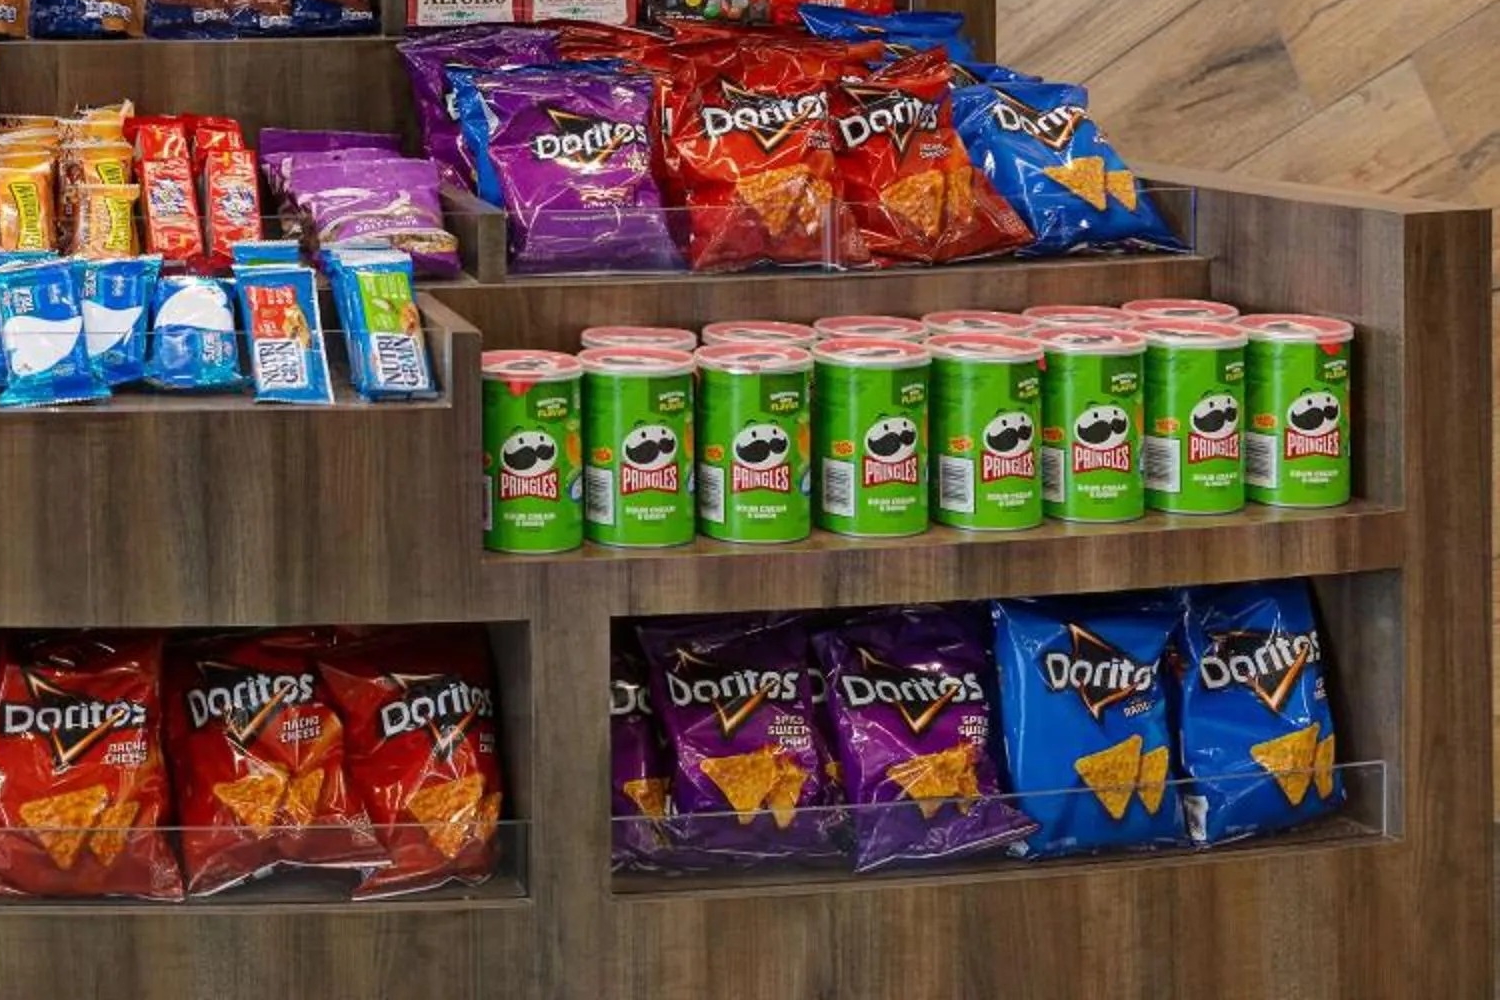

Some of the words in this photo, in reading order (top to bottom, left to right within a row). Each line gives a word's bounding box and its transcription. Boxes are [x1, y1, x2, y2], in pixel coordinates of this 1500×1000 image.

[536, 121, 647, 159] Doritos
[376, 335, 405, 387] NUTRI
[1075, 445, 1130, 472] PRINGLES
[1287, 431, 1339, 458] PRINGLES
[622, 465, 677, 493] PRINGLES
[733, 464, 789, 492] PRINGLES
[865, 456, 917, 485] PRINGLES
[983, 452, 1034, 483] PRINGLES
[500, 471, 557, 499] PRINGLES
[188, 672, 316, 728] Doritos
[667, 667, 799, 708] Doritos
[842, 671, 984, 707] Doritos
[4, 700, 147, 733] Doritos
[282, 715, 320, 732] NACHO
[381, 681, 494, 737] Doritos
[280, 724, 321, 743] CHEESE
